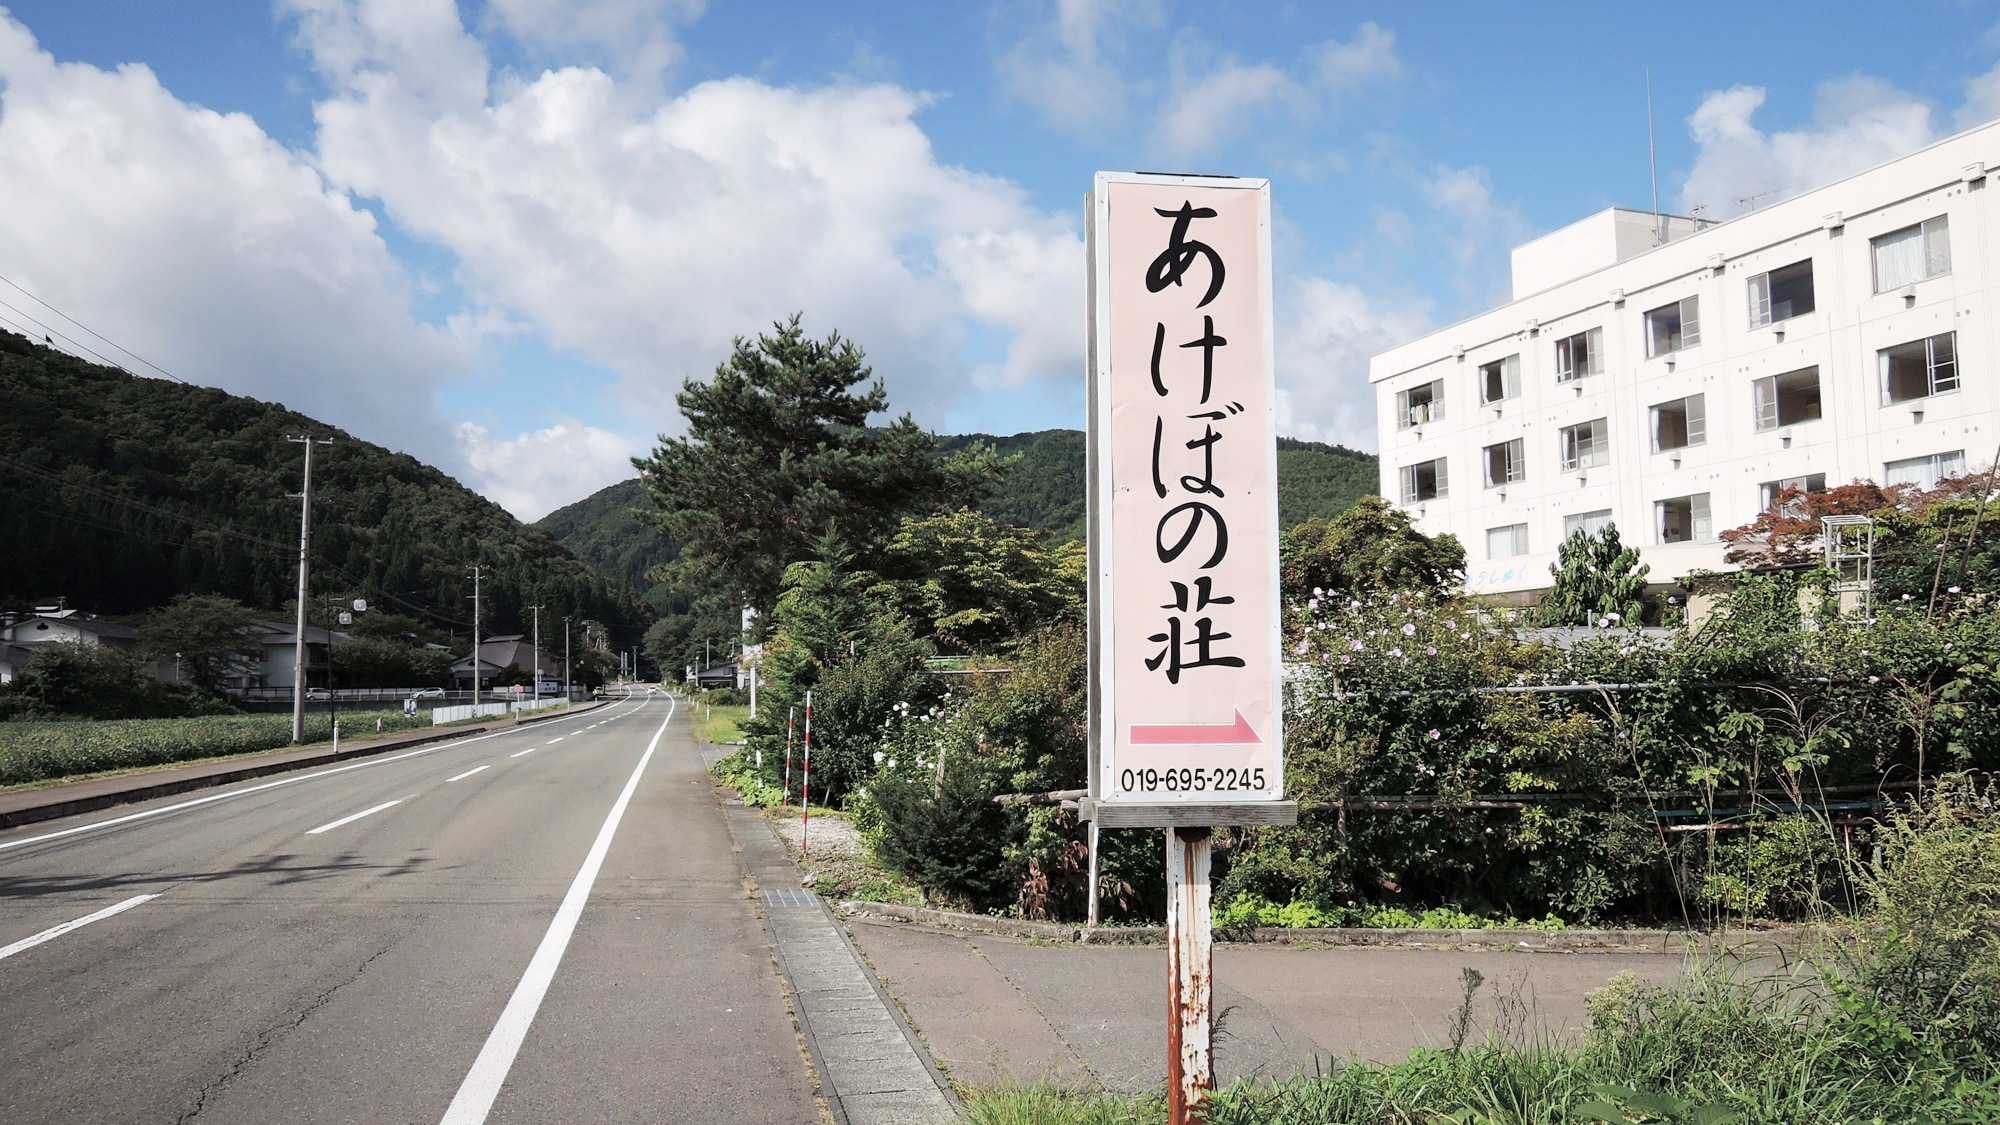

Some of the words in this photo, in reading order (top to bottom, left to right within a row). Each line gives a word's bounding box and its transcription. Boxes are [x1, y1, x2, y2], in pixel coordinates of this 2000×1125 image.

[1144, 200, 1246, 685] あけぼの荘
[1121, 767, 1265, 792] 019-695-2245
